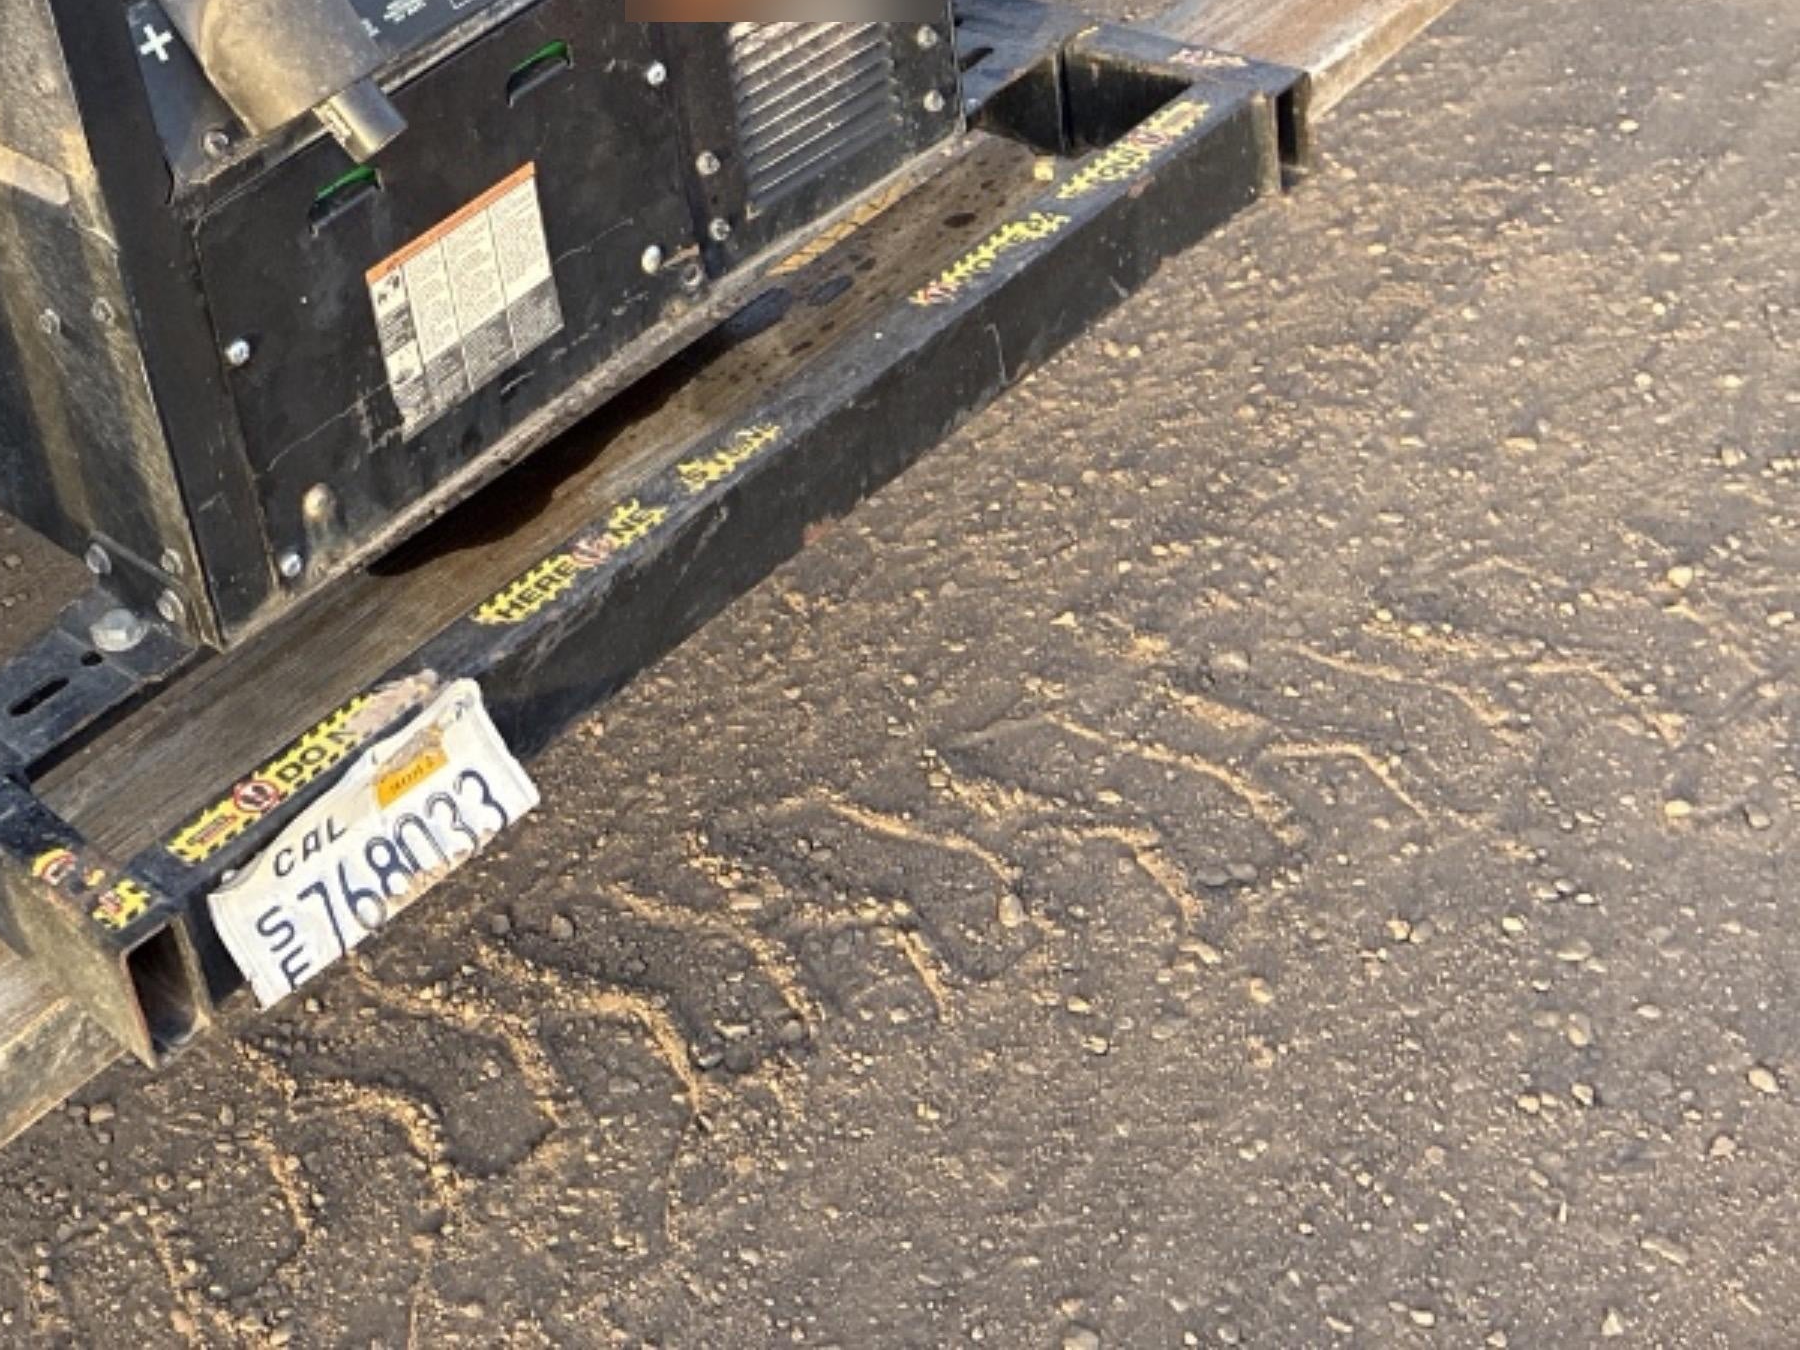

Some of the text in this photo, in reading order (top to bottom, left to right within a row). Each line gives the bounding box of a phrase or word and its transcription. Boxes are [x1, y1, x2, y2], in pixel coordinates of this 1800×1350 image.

[494, 559, 576, 621] HERE
[276, 745, 328, 785] DO
[272, 816, 349, 878] CAL
